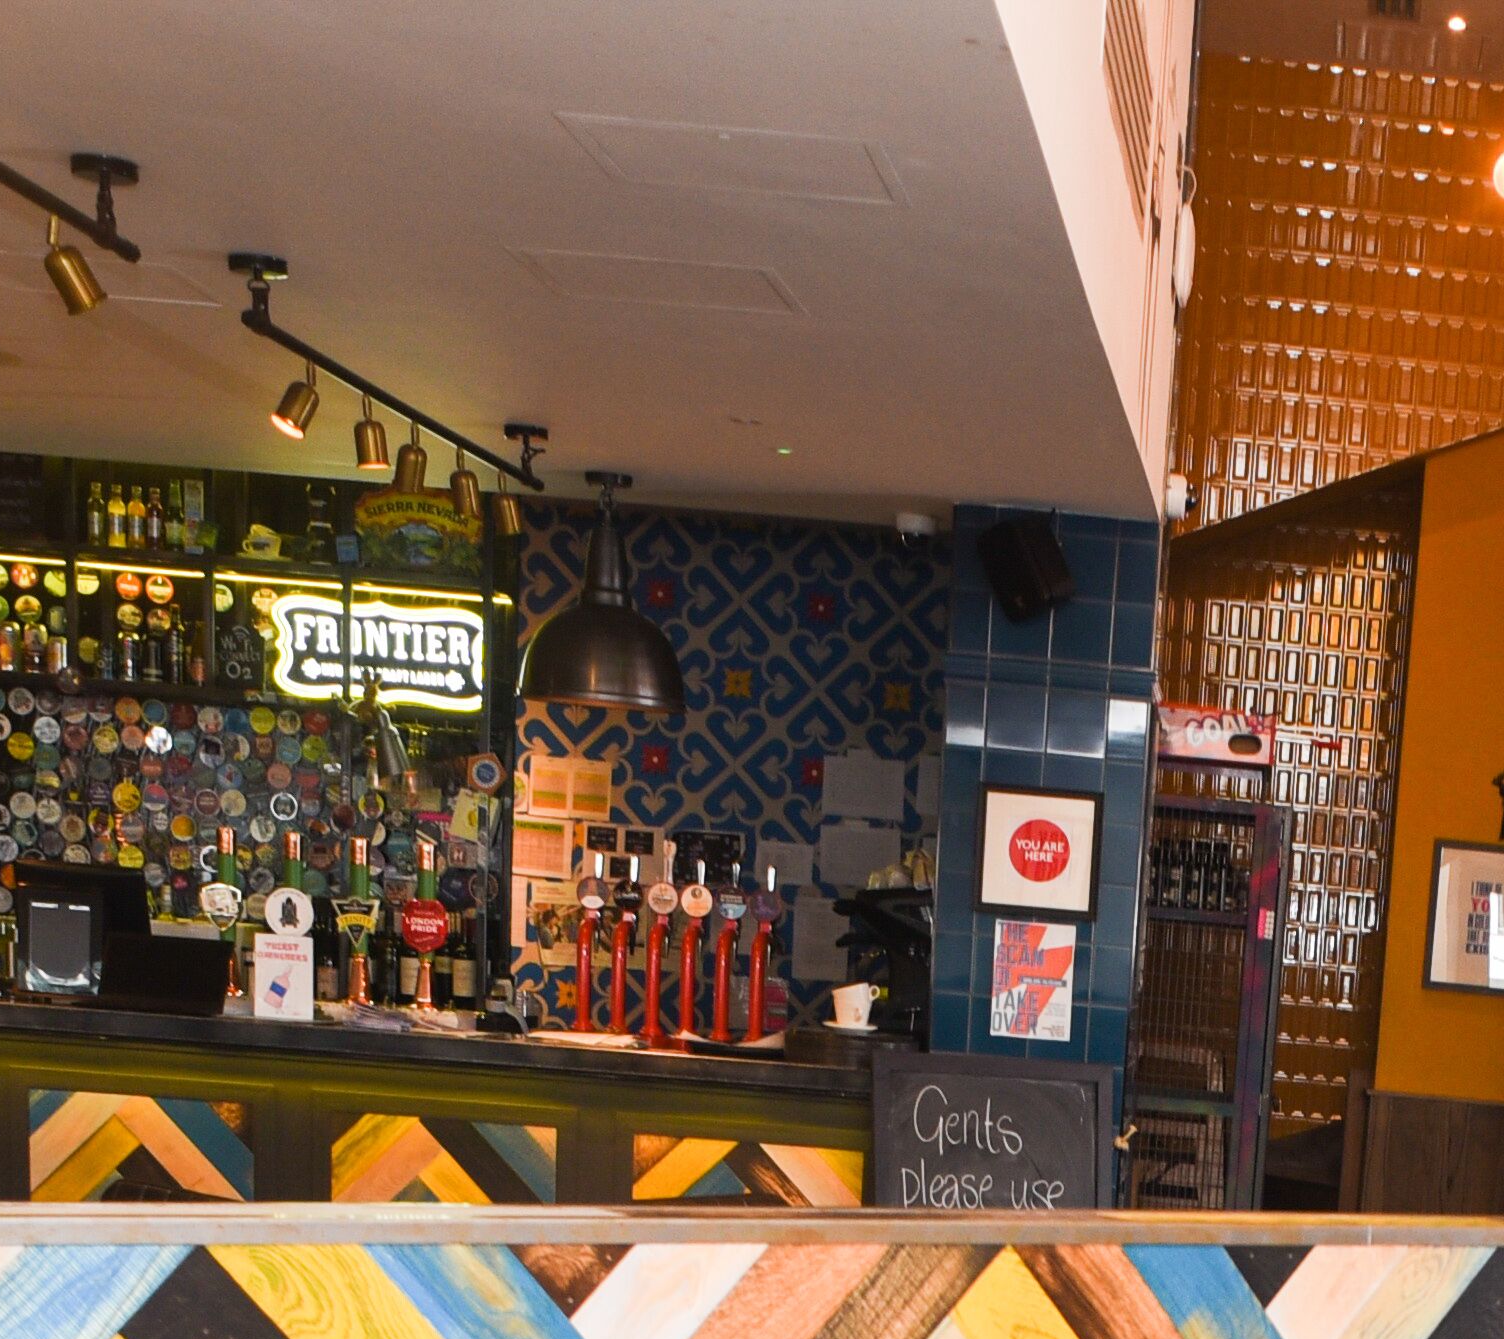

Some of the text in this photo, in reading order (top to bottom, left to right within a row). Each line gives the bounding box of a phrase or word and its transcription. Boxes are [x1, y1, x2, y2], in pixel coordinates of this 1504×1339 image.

[364, 501, 414, 516] SIERRA
[293, 612, 472, 667] FRONTIER
[1186, 713, 1253, 748] GOAL
[1016, 838, 1065, 853] YOU ARE
[1024, 850, 1054, 863] HERE
[1472, 897, 1490, 912] YO
[405, 917, 444, 927] LONDON
[410, 924, 438, 934] PRIDE
[996, 988, 1040, 1012] TAKE
[991, 1011, 1039, 1035] OVER
[913, 1084, 1023, 1156] Gents
[901, 1157, 1065, 1210] please use
